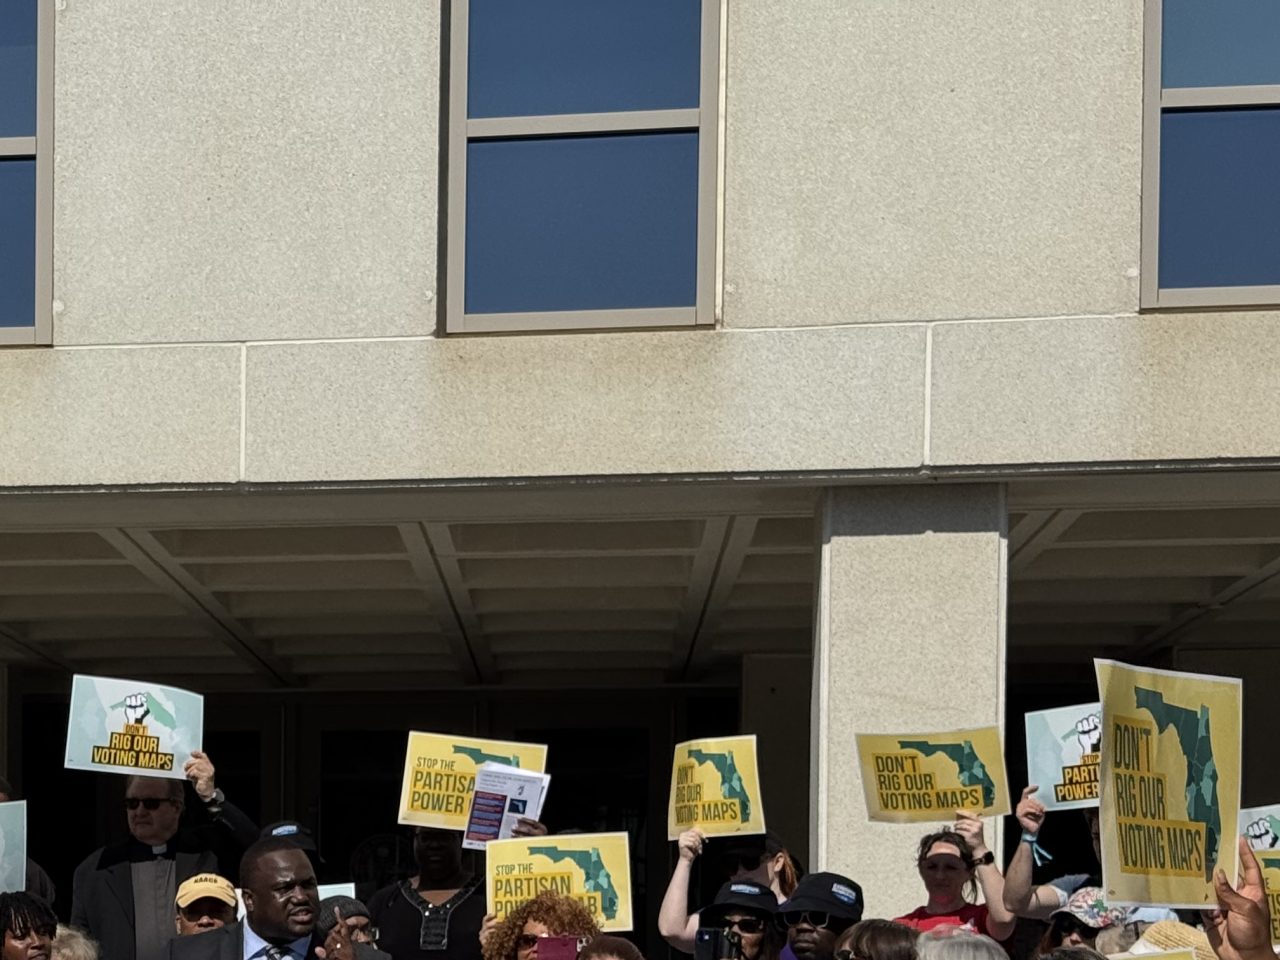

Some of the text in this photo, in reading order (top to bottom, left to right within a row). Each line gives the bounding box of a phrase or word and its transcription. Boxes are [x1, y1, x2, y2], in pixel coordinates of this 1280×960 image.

[111, 733, 159, 752] RIG OUR
[1114, 723, 1152, 772] DON'T
[93, 747, 173, 770] VOTING MAPS
[416, 756, 456, 772] STOP THE
[875, 755, 918, 773] DON'T
[413, 770, 476, 795] PARTISA
[878, 772, 935, 791] RIG OUR
[1063, 765, 1099, 784] PARTI
[410, 790, 465, 815] POWER
[880, 788, 980, 810] VOTING MAPS
[1115, 772, 1166, 821] RIG OUR
[701, 801, 738, 822] MAPS
[1118, 821, 1202, 873] VOTING MAPS
[495, 863, 533, 876] STOP THE
[494, 875, 571, 899] PARTISAN
